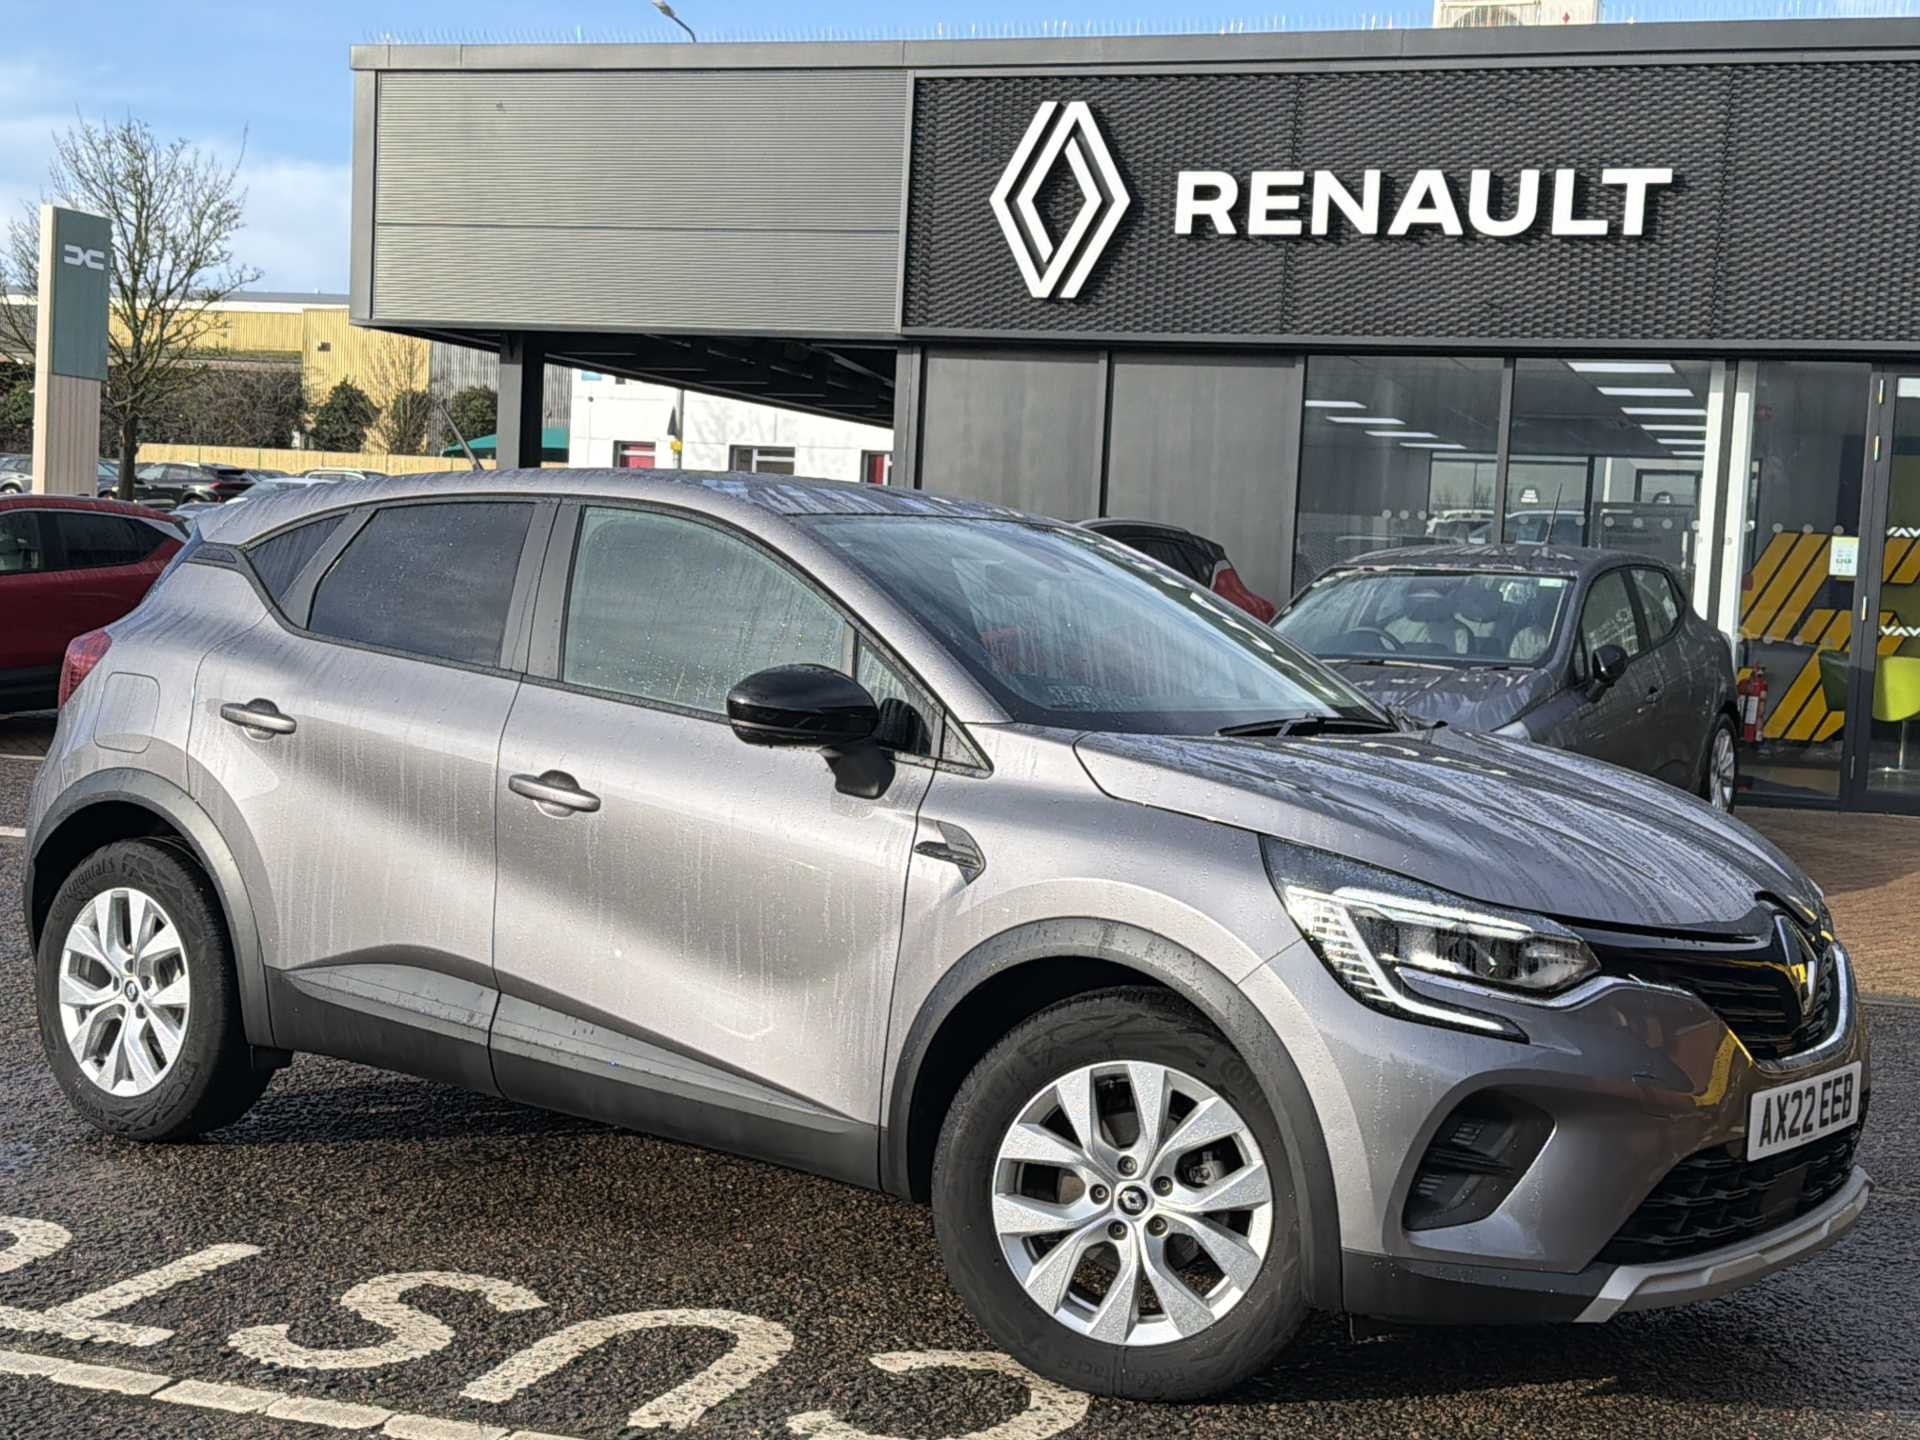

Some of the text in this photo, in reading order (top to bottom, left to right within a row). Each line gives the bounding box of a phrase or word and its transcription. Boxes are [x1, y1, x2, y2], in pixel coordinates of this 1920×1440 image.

[1174, 168, 1673, 236] RENAULT
[1759, 1072, 1853, 1147] AX22 EEB
[0, 1216, 1090, 1440] CUST
